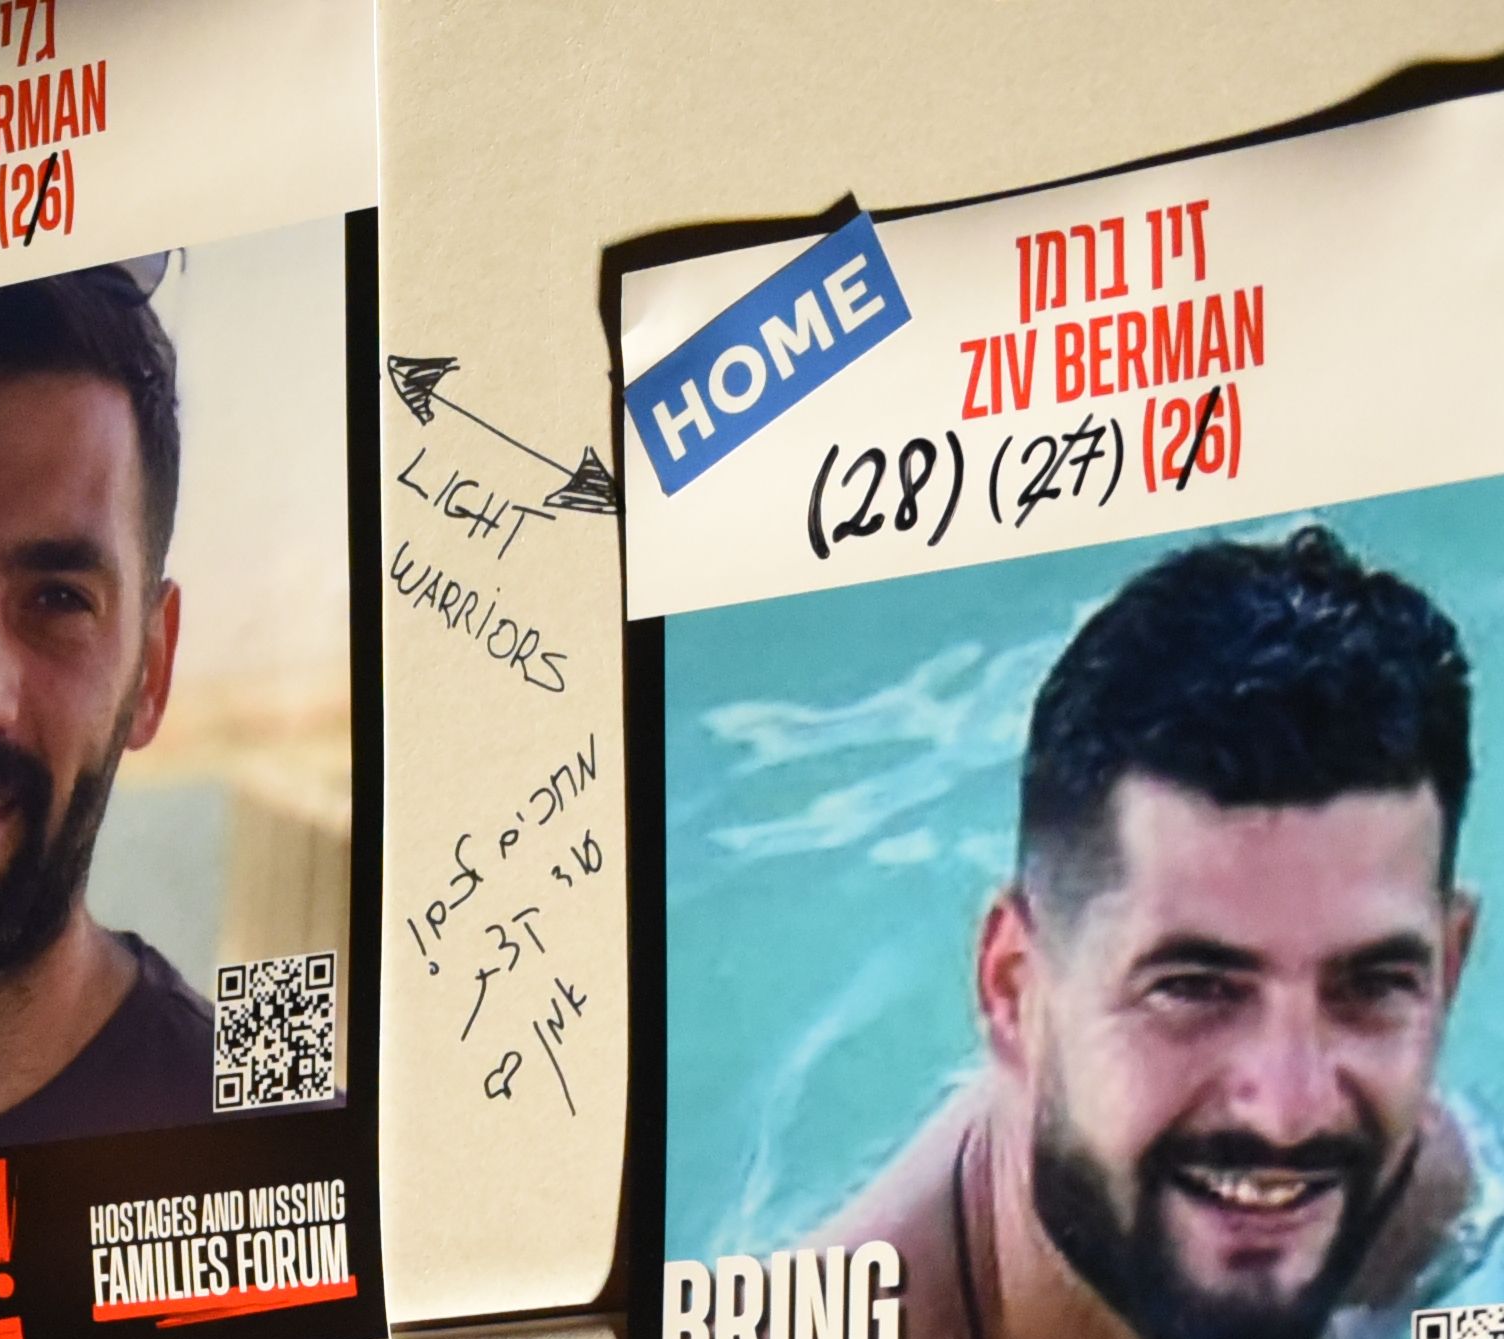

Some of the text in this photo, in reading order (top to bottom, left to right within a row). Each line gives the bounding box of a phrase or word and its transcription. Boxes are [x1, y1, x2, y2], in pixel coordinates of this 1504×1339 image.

[0, 0, 56, 67] גלי
[1014, 198, 1211, 325] זיו ברמן
[652, 253, 886, 464] HOME
[958, 284, 1266, 422] ZIV BERMAN
[396, 447, 557, 560] LIGHT
[807, 430, 965, 561] (28)
[90, 1178, 347, 1247] HOSTAGES AND MISSING
[92, 1222, 350, 1309] FAMILIES FORUM
